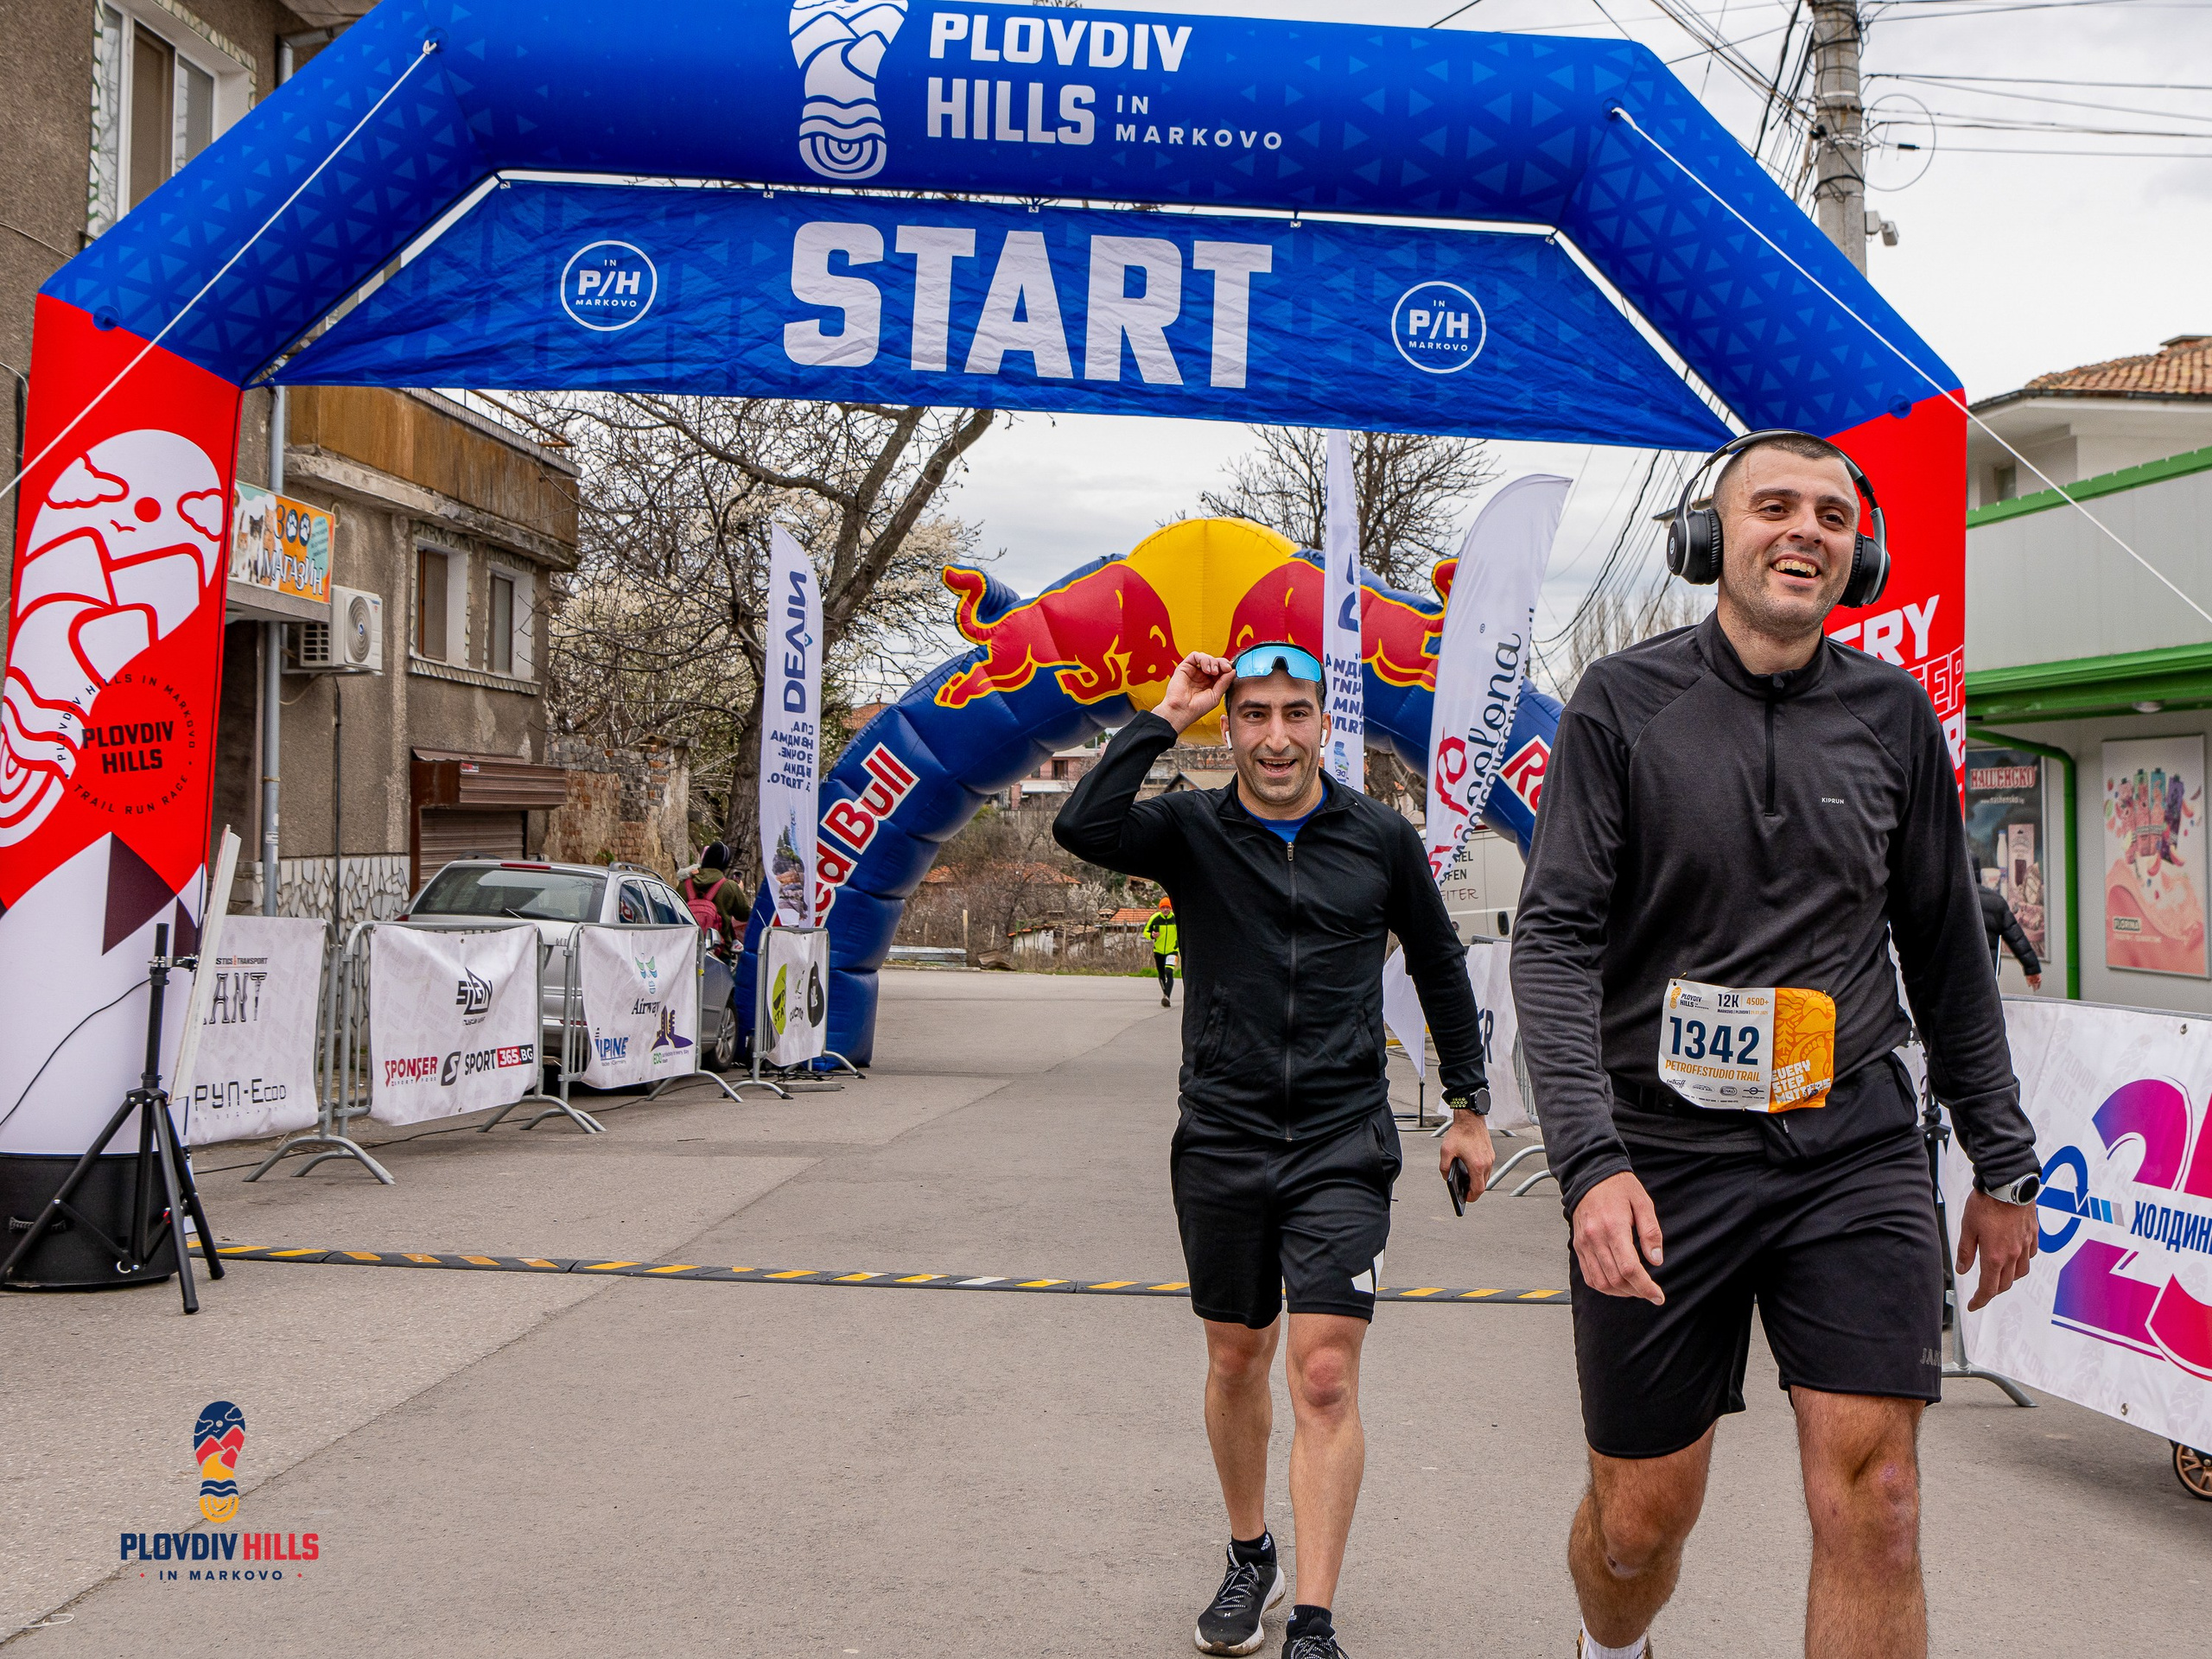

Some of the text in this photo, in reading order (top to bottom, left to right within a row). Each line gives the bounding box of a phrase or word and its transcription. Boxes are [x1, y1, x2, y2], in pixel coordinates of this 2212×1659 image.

[929, 13, 1193, 73] PLOVDIV
[927, 77, 1096, 145] HILLS
[1116, 94, 1149, 114] IN
[1115, 124, 1283, 150] MARKOVO
[578, 270, 641, 296] P/H
[575, 299, 638, 308] MARKOVO
[783, 221, 1274, 389] START
[1408, 308, 1469, 340] P/H
[1408, 340, 1469, 352] MARKOVO
[261, 548, 324, 596] МАГАЗИН
[1906, 644, 1965, 717] EP
[56, 696, 82, 761] PLOVDIV
[143, 674, 157, 687] IN
[81, 720, 175, 749] PLOVDIV
[102, 748, 162, 774] HILLS
[73, 774, 188, 815] TRAIL RUN RACE
[824, 746, 915, 851] Bull
[203, 972, 268, 1025] ANT
[632, 998, 660, 1017] Airway
[1717, 994, 1739, 1007] 12K
[1669, 1016, 1759, 1065] 1342
[385, 1056, 438, 1088] SPONSER
[1665, 1059, 1760, 1082] PETROFF.STUDIO TRAIL
[1772, 1074, 1804, 1094] STEP
[2130, 1200, 2212, 1255] ХОЛДИН
